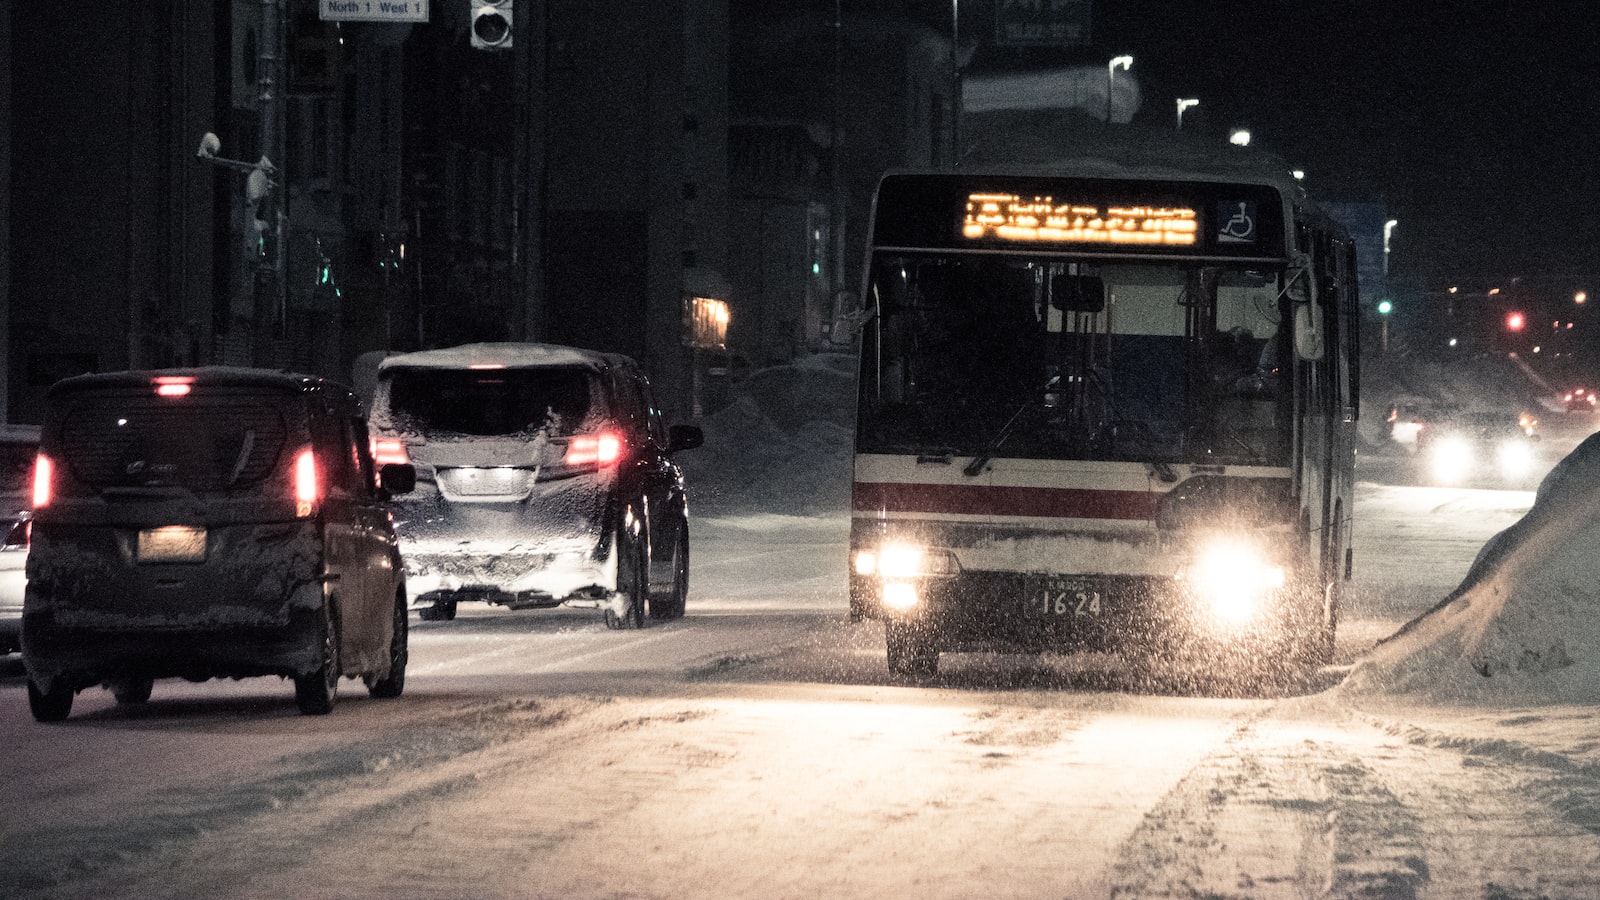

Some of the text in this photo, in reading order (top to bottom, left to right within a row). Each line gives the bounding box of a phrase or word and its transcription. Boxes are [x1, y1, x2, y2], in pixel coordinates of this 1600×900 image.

[328, 1, 359, 13] North
[366, 2, 371, 13] 1
[380, 2, 408, 13] West
